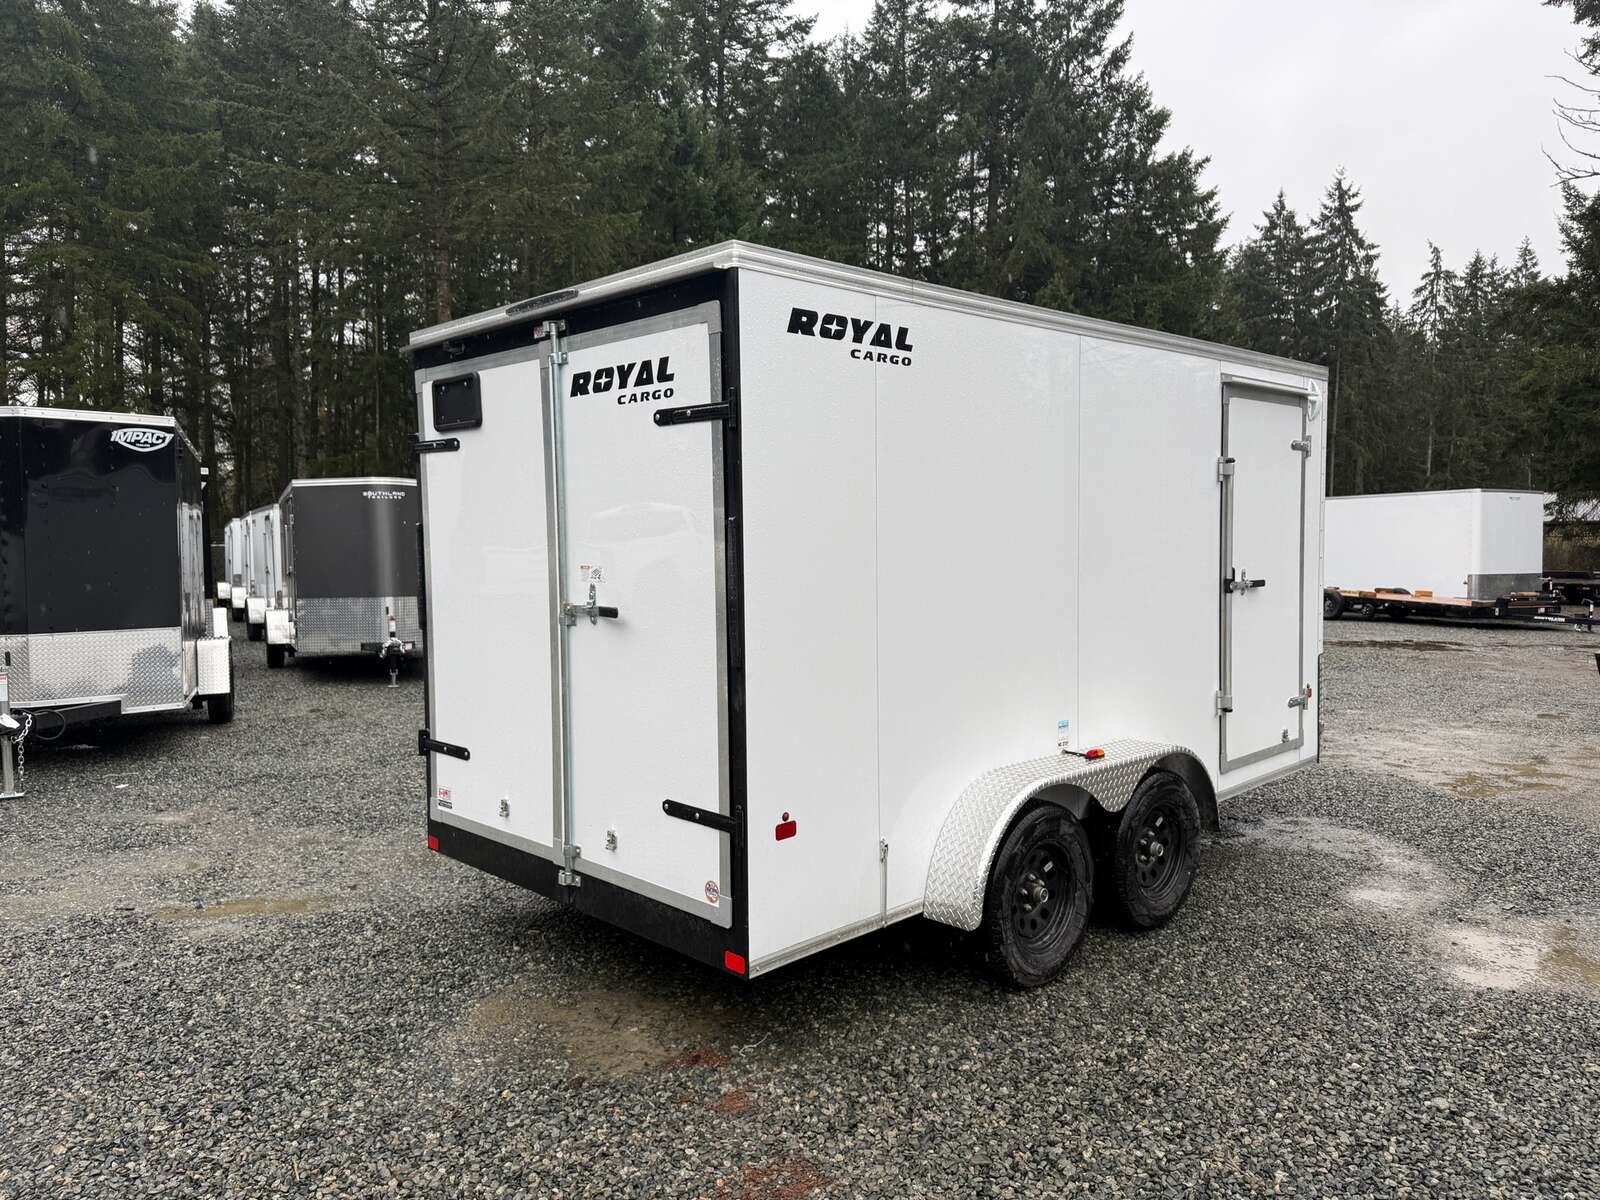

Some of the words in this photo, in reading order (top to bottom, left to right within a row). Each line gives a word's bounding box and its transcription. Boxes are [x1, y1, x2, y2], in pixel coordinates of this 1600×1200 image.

[788, 307, 914, 352] ROYAL
[850, 349, 912, 367] CARGO
[570, 356, 675, 398] ROYAL
[617, 388, 674, 405] CARGO
[110, 430, 174, 445] IMPACT
